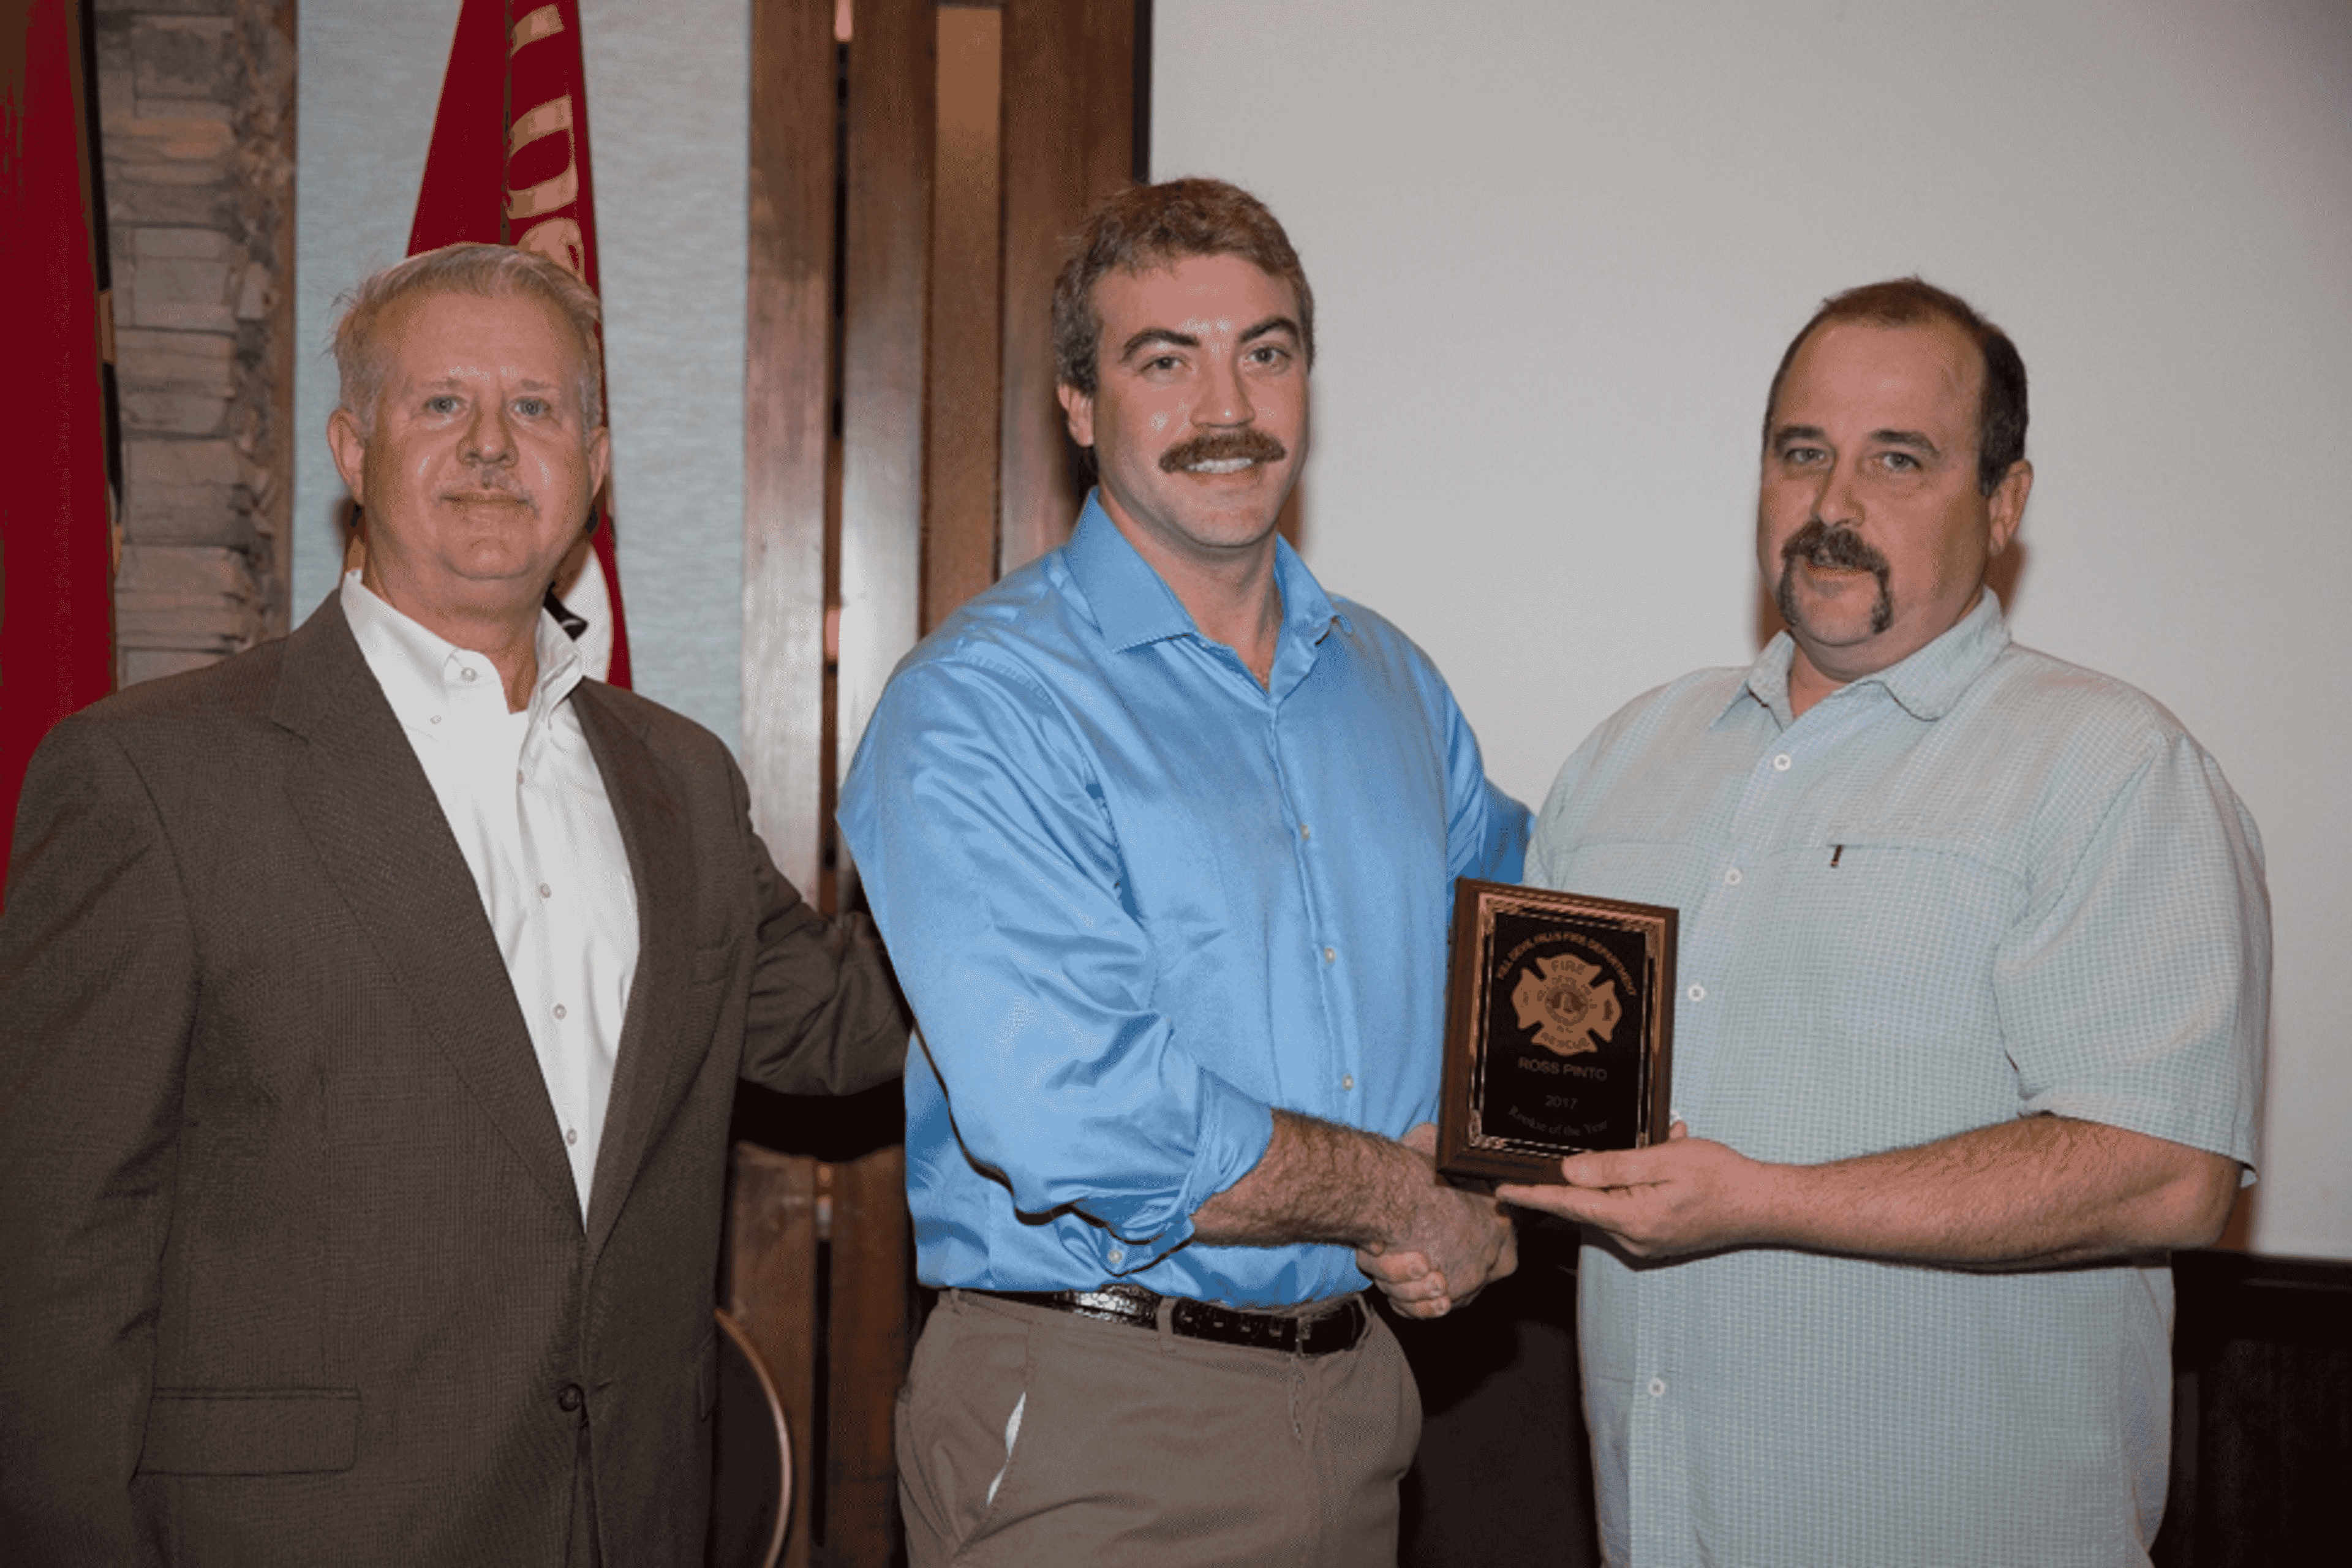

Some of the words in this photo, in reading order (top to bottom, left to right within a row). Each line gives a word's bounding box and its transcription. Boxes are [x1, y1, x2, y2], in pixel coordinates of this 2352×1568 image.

[1551, 960, 1585, 976] FIRE
[1518, 1057, 1559, 1074] ROSS
[1563, 1063, 1608, 1082] PINTO
[1545, 1095, 1578, 1110] 2017
[1548, 1124, 1562, 1134] of
[1563, 1125, 1580, 1136] the
[1583, 1120, 1608, 1134] Year
